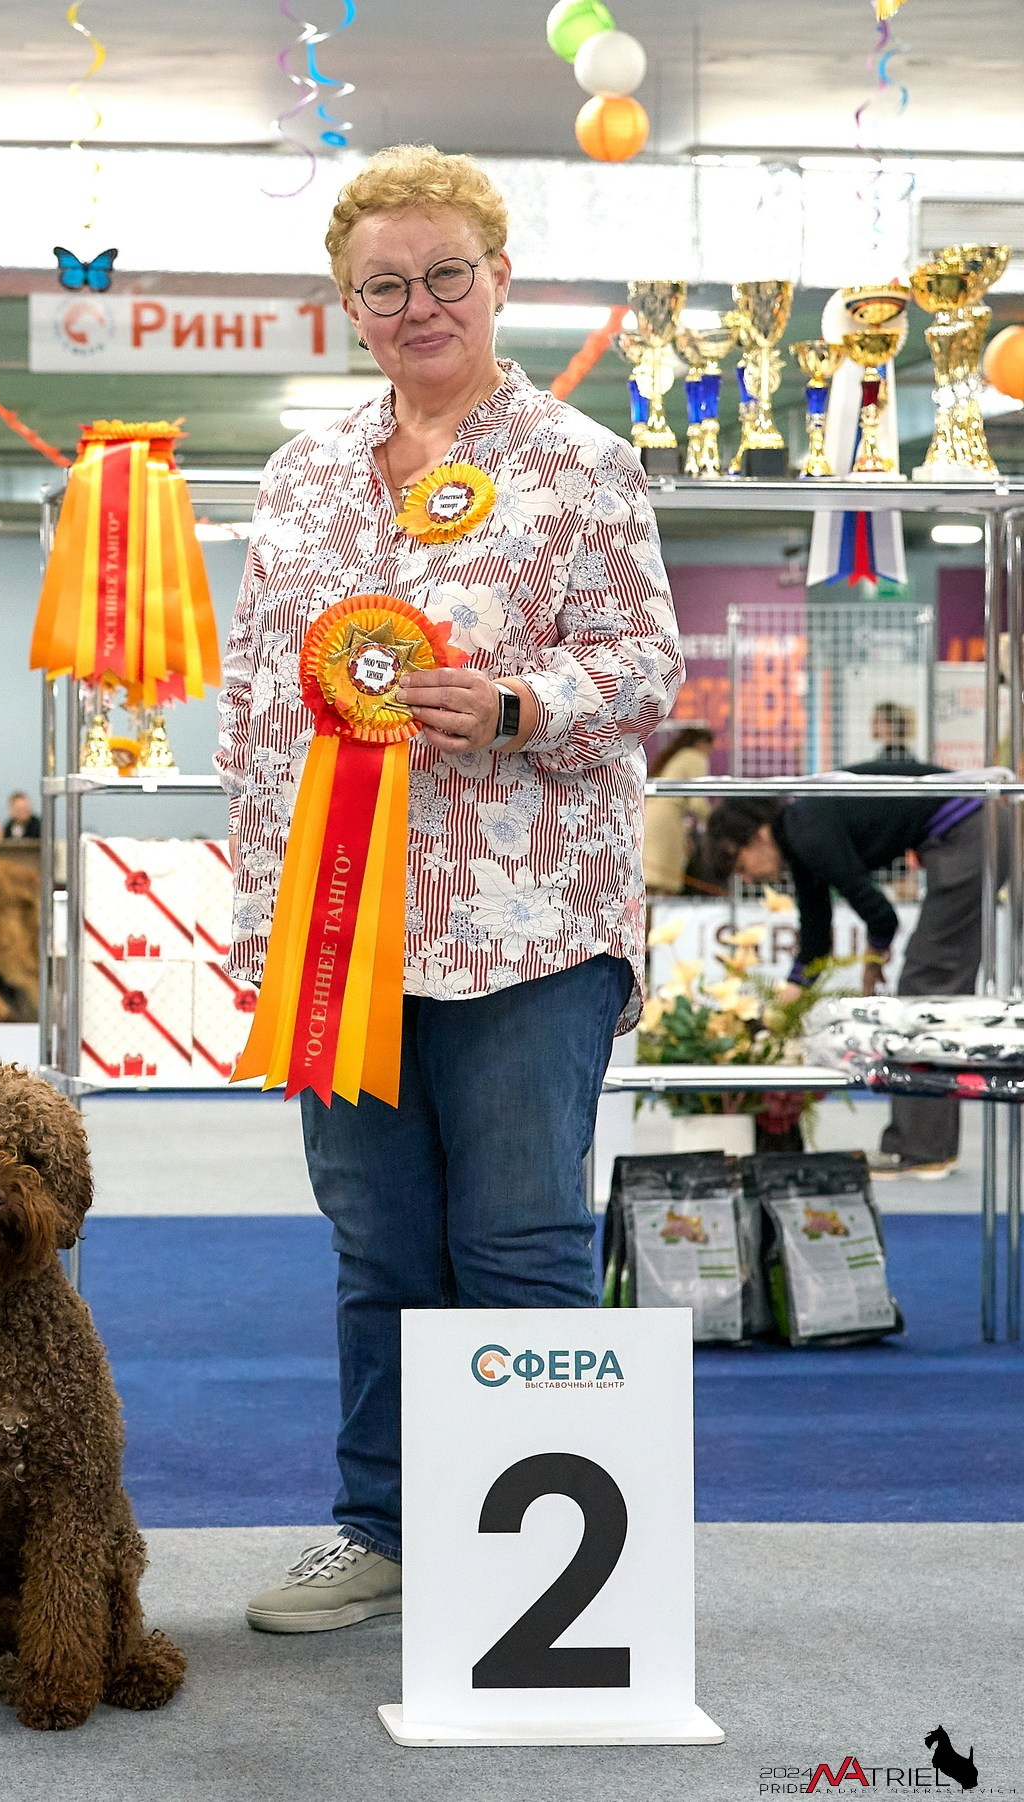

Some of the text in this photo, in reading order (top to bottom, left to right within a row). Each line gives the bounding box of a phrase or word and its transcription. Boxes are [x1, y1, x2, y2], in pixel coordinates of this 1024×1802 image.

[132, 301, 326, 356] Ринг 1
[104, 574, 119, 657] "ОСЕННЕЕ
[304, 843, 352, 1068] "ОСЕННЕЕ ТАНГО"
[471, 1344, 625, 1388] СФЕРА
[525, 1381, 625, 1389] ВЫСТАВОЧНЫЙ ЦЕНТР
[472, 1452, 631, 1689] 2
